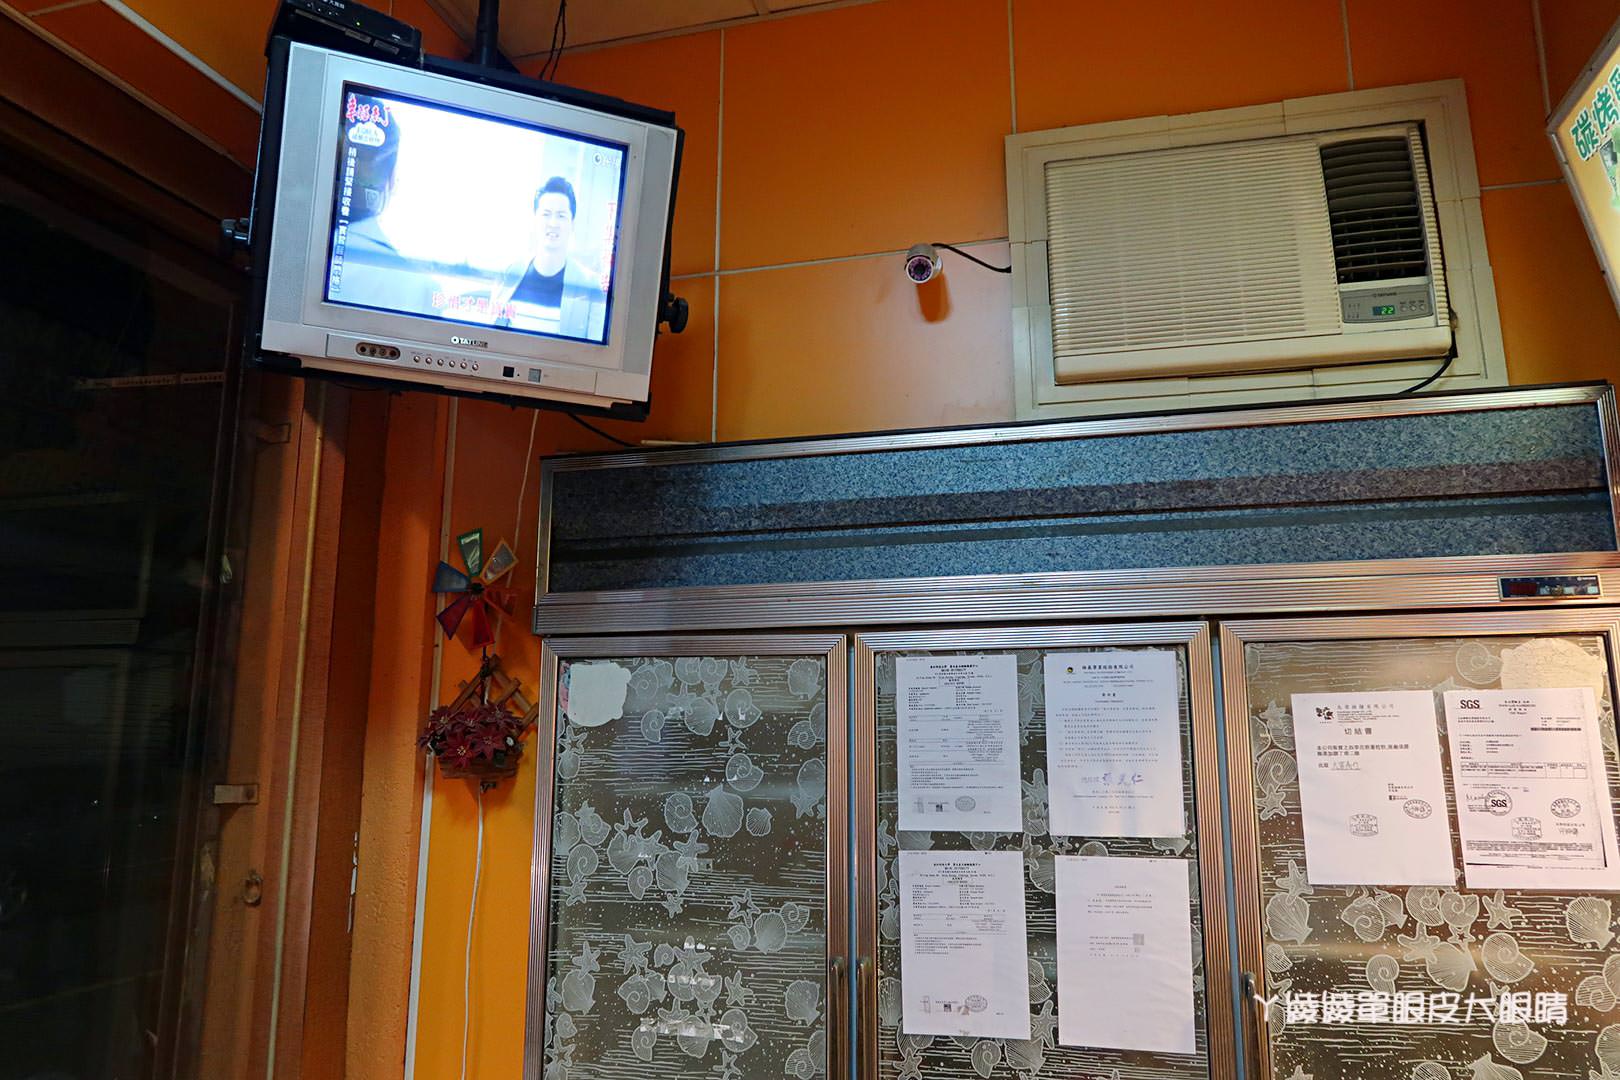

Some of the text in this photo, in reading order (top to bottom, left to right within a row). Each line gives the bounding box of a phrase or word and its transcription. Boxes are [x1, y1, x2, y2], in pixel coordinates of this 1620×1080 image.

[1381, 306, 1394, 315] 22
[1460, 699, 1480, 709] SGS
[1344, 727, 1372, 735] 切結書
[1490, 799, 1507, 808] SGS
